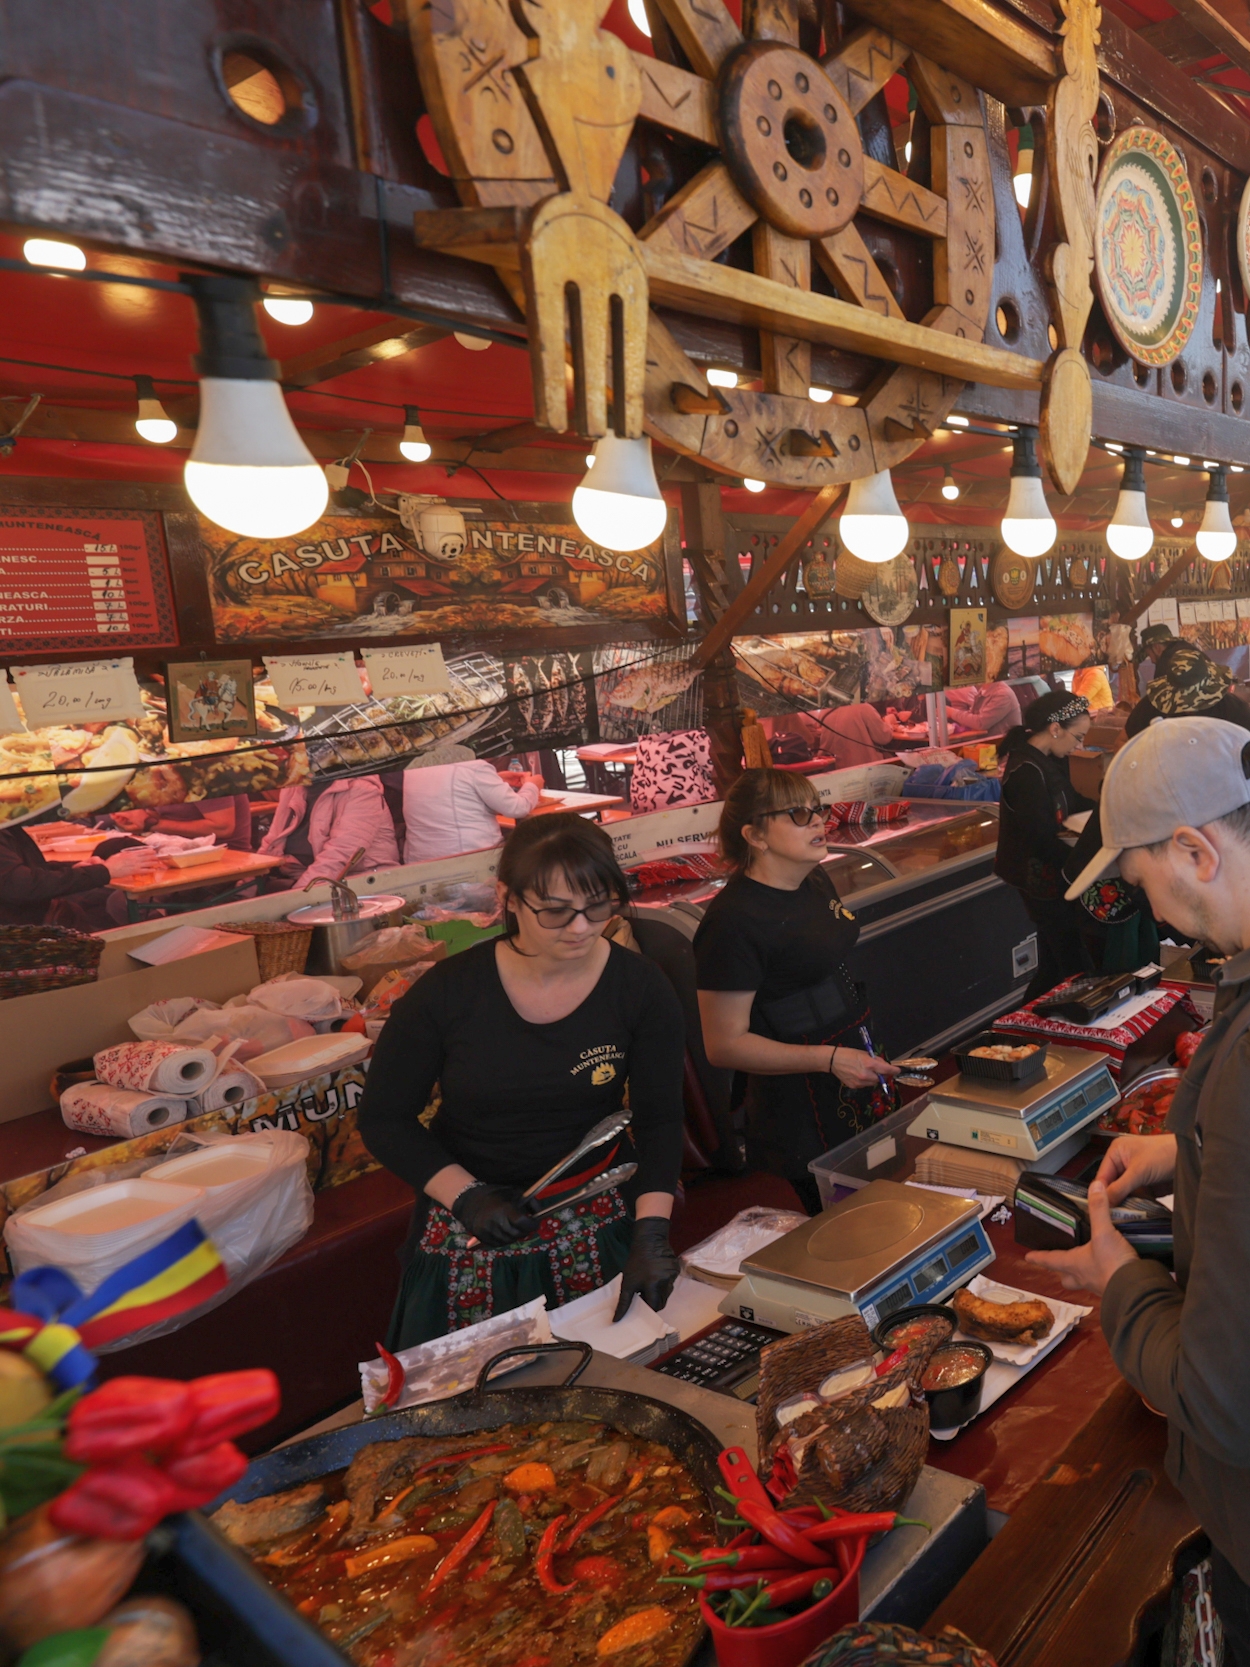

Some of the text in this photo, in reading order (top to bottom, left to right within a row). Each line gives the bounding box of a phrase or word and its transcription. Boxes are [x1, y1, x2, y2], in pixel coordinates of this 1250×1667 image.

[1, 555, 38, 564] NESC
[470, 530, 650, 582] NTENEASCĂ
[612, 833, 632, 842] TATE
[252, 1080, 364, 1134] MUN
